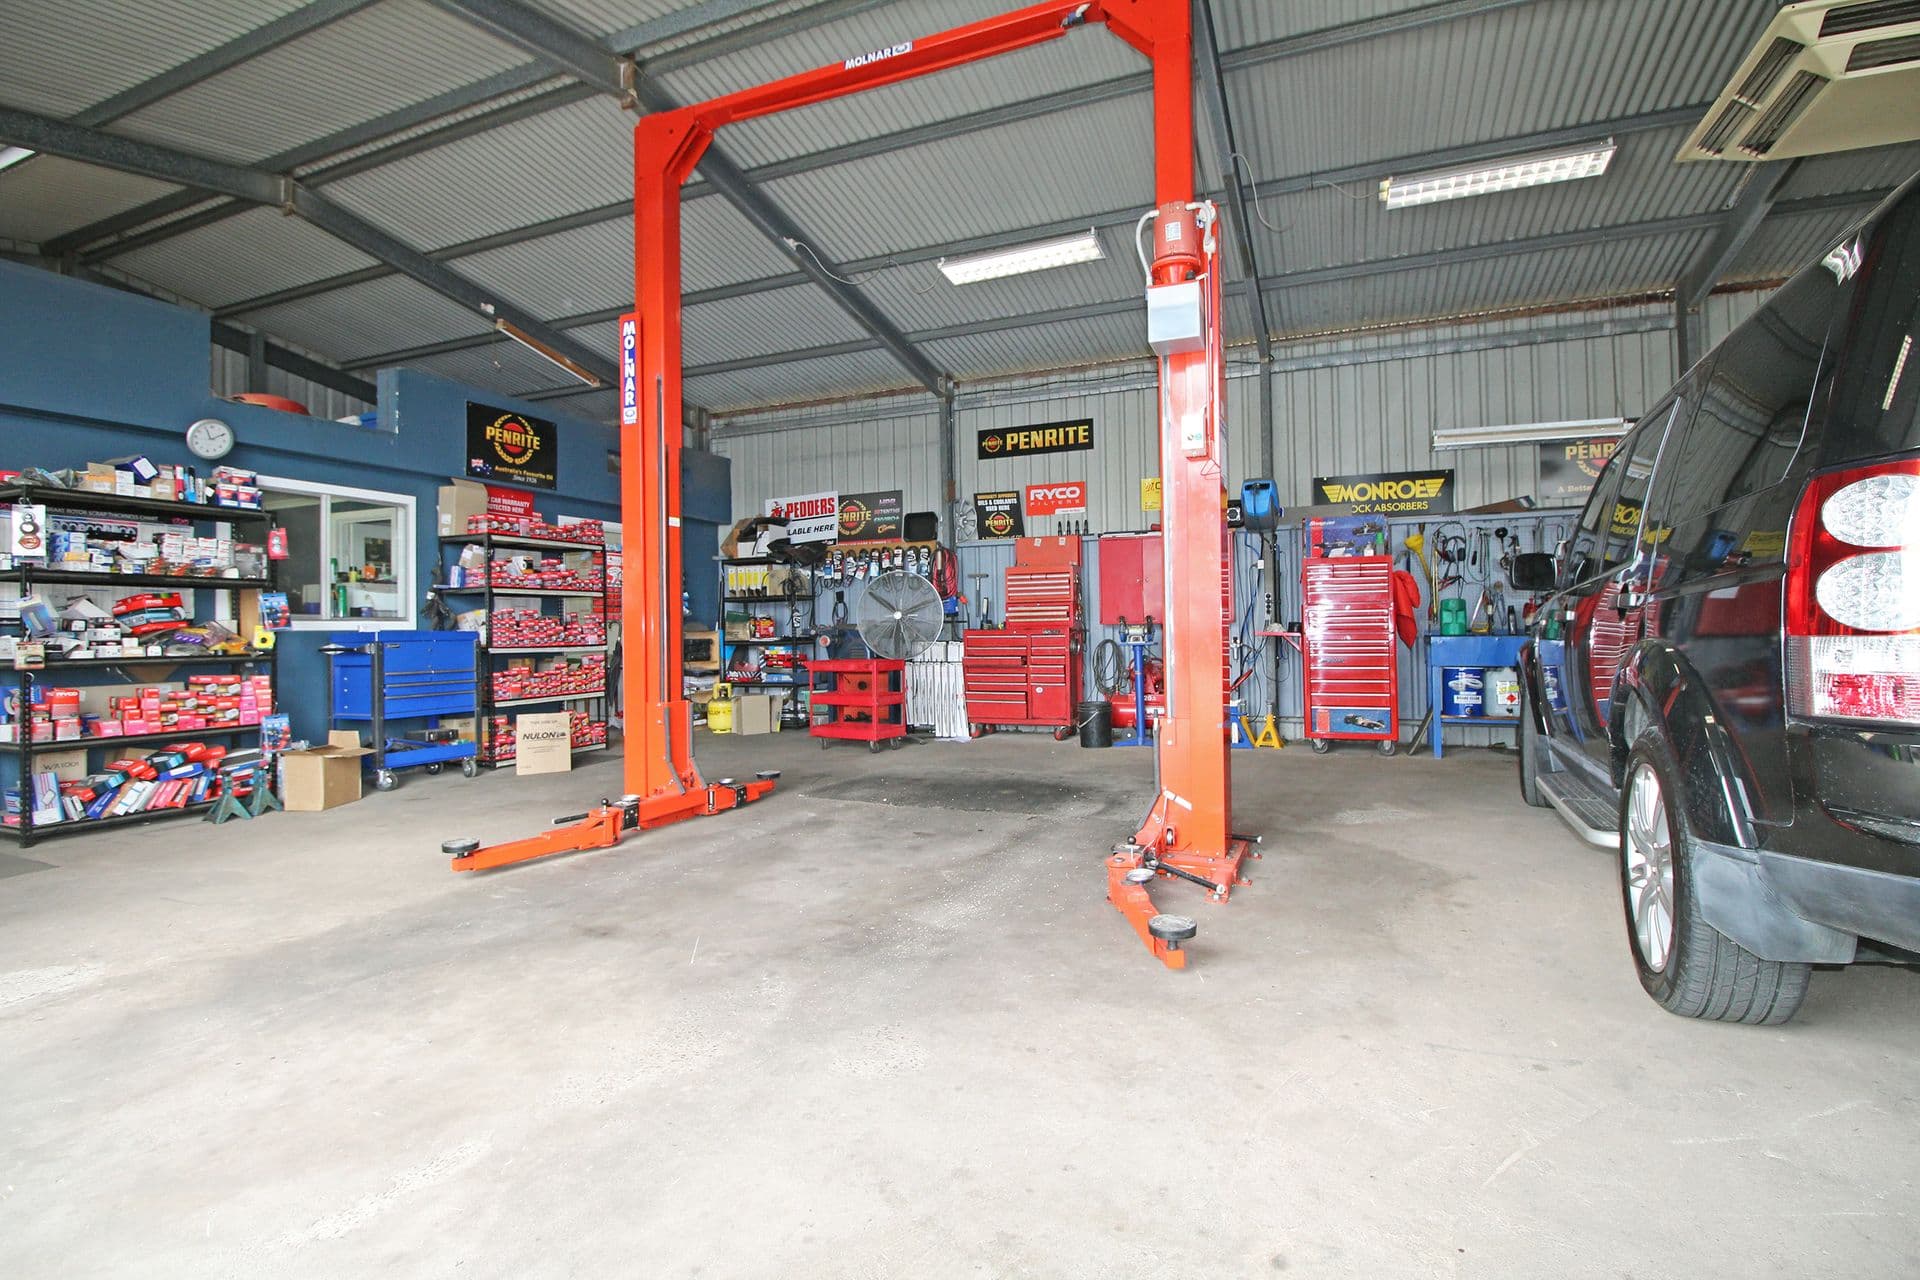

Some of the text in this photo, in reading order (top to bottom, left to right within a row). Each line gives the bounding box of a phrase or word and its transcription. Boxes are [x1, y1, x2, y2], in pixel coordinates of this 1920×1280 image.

[845, 48, 891, 70] MOLNAR
[623, 320, 636, 406] MOLNAR
[485, 426, 541, 450] PENRITE
[1006, 425, 1089, 451] PENRITE
[1565, 442, 1618, 461] PENR
[1030, 486, 1080, 500] RYCO
[1338, 479, 1426, 503] MONROE
[1567, 484, 1594, 493] Bette
[488, 504, 511, 512] OTECTED
[490, 496, 530, 508] CAR WARRANTY
[785, 497, 835, 519] PEDDERS
[1352, 501, 1429, 513] OCK ABSORBERS
[838, 510, 872, 522] ENRITE
[985, 518, 1014, 527] PENRITE
[787, 523, 835, 536] LABLE HERE
[522, 731, 556, 740] NULON
